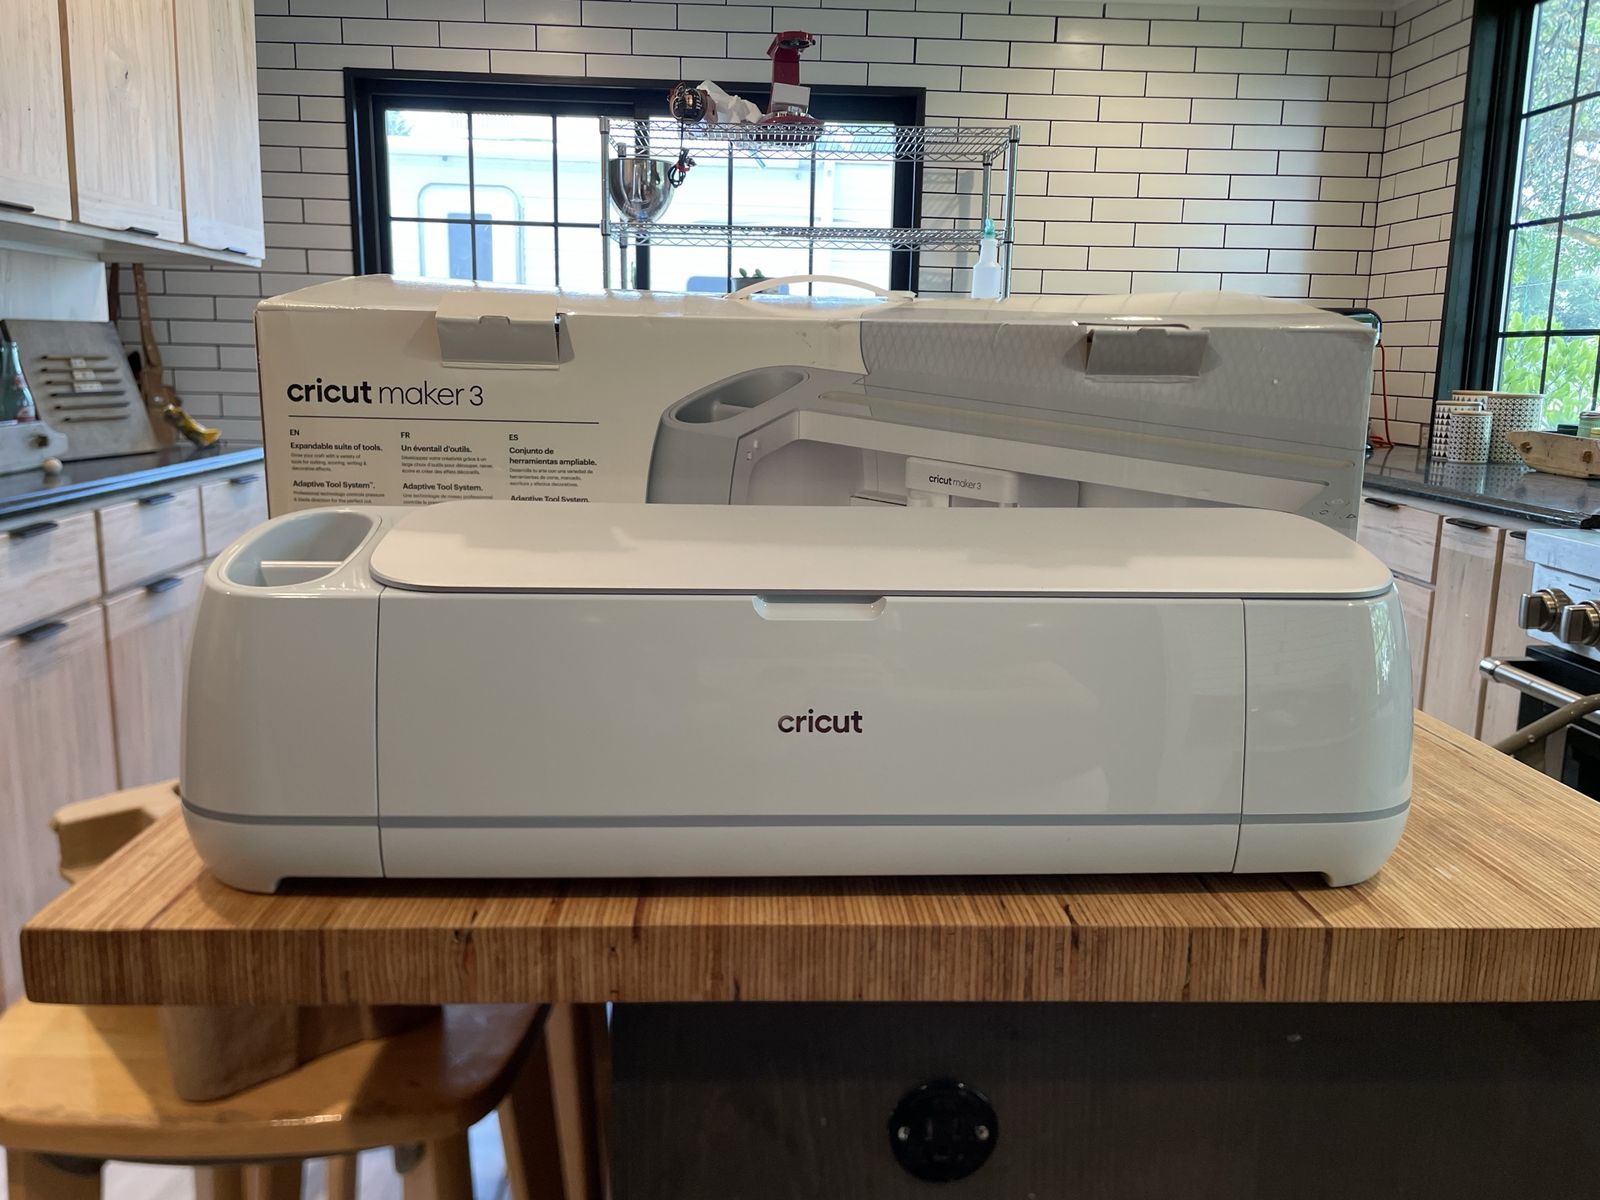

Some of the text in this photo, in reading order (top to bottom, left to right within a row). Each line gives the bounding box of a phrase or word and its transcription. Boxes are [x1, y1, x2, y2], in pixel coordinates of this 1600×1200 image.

[287, 378, 484, 406] cricut maker 3
[291, 442, 333, 450] Expandable
[509, 447, 543, 455] Conjunto
[509, 457, 597, 466] herramientas ampliable.
[293, 480, 325, 488] Adaptive
[928, 475, 982, 490] cricut maker 3
[403, 483, 436, 491] Adaptive
[454, 484, 483, 492] System.
[778, 708, 863, 734] cricut
